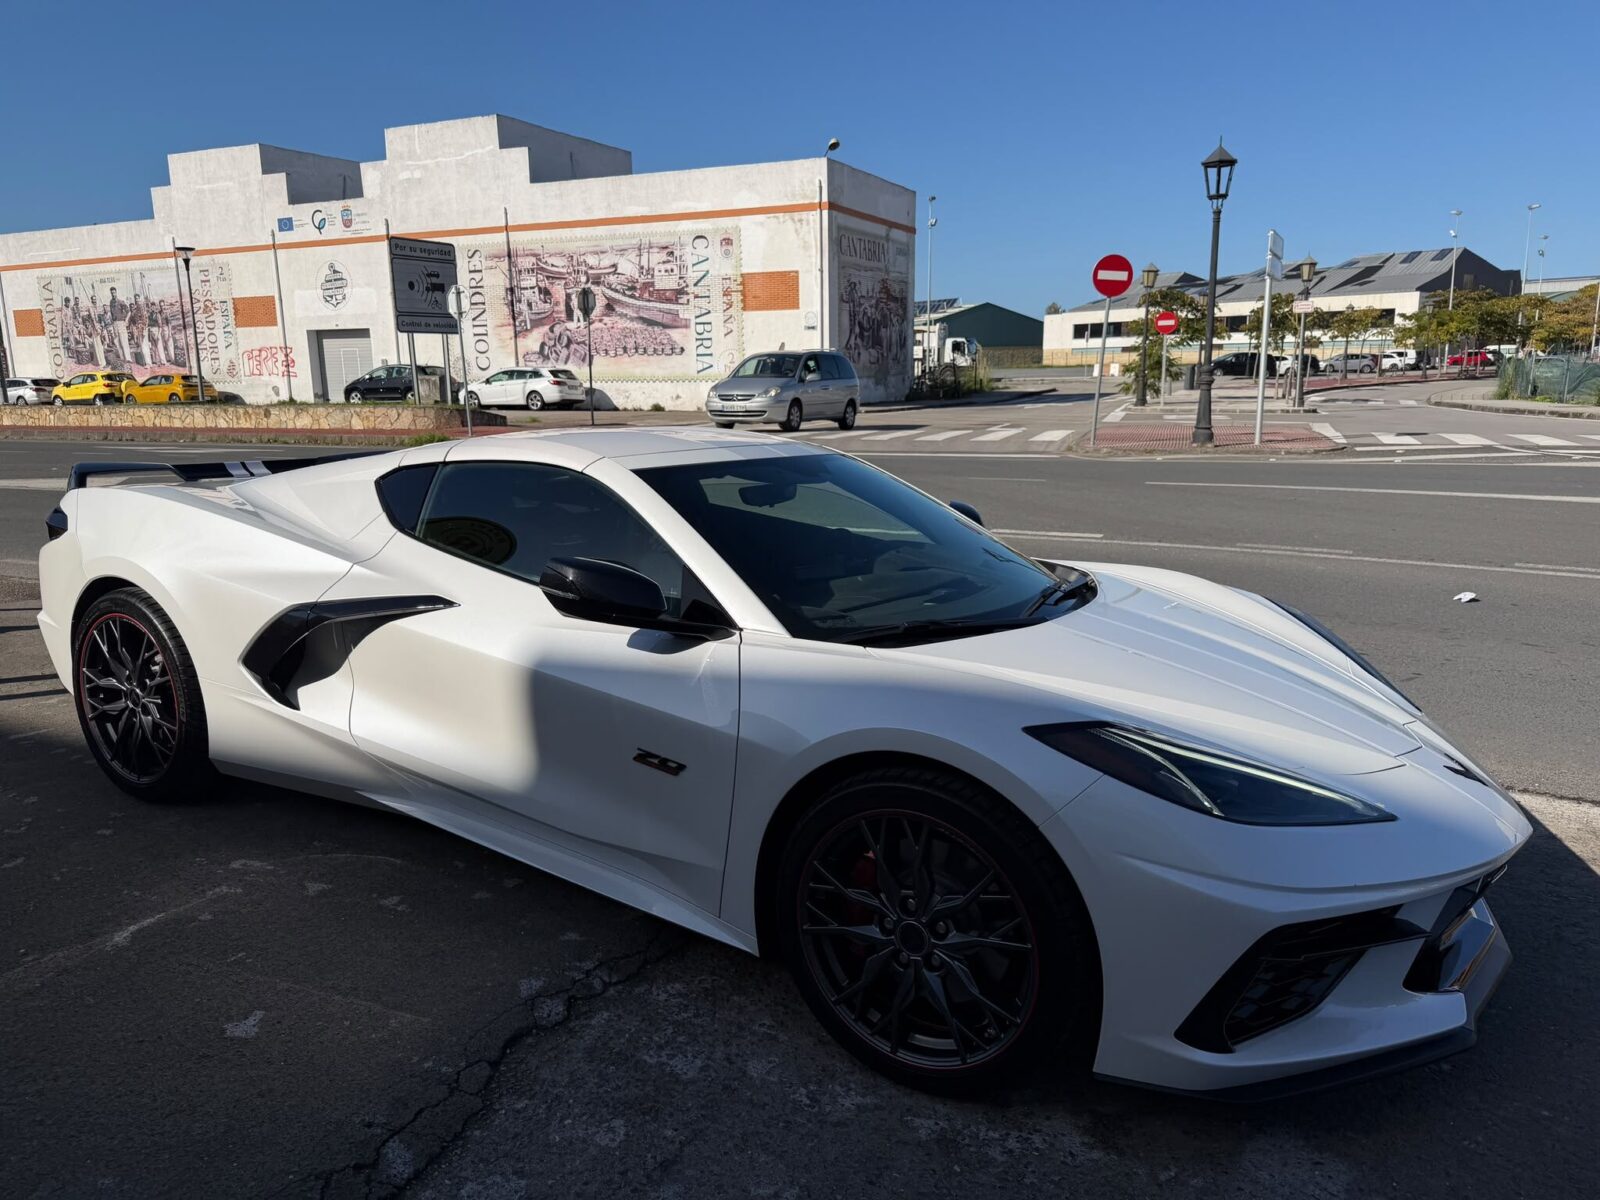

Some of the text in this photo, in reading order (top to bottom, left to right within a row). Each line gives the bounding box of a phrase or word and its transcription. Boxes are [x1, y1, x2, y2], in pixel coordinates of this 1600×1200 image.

[394, 243, 406, 251] Por
[420, 247, 452, 257] seguridad
[840, 233, 886, 263] CANTABRIA
[218, 266, 224, 276] 2
[191, 288, 202, 315] SAN
[467, 249, 491, 371] COLINDRES
[691, 235, 714, 374] CANTABRIA
[722, 276, 736, 338] ESPAÑA
[42, 280, 65, 380] COFRADIA
[219, 300, 233, 350] ESPAÑA
[401, 320, 422, 328] Control
